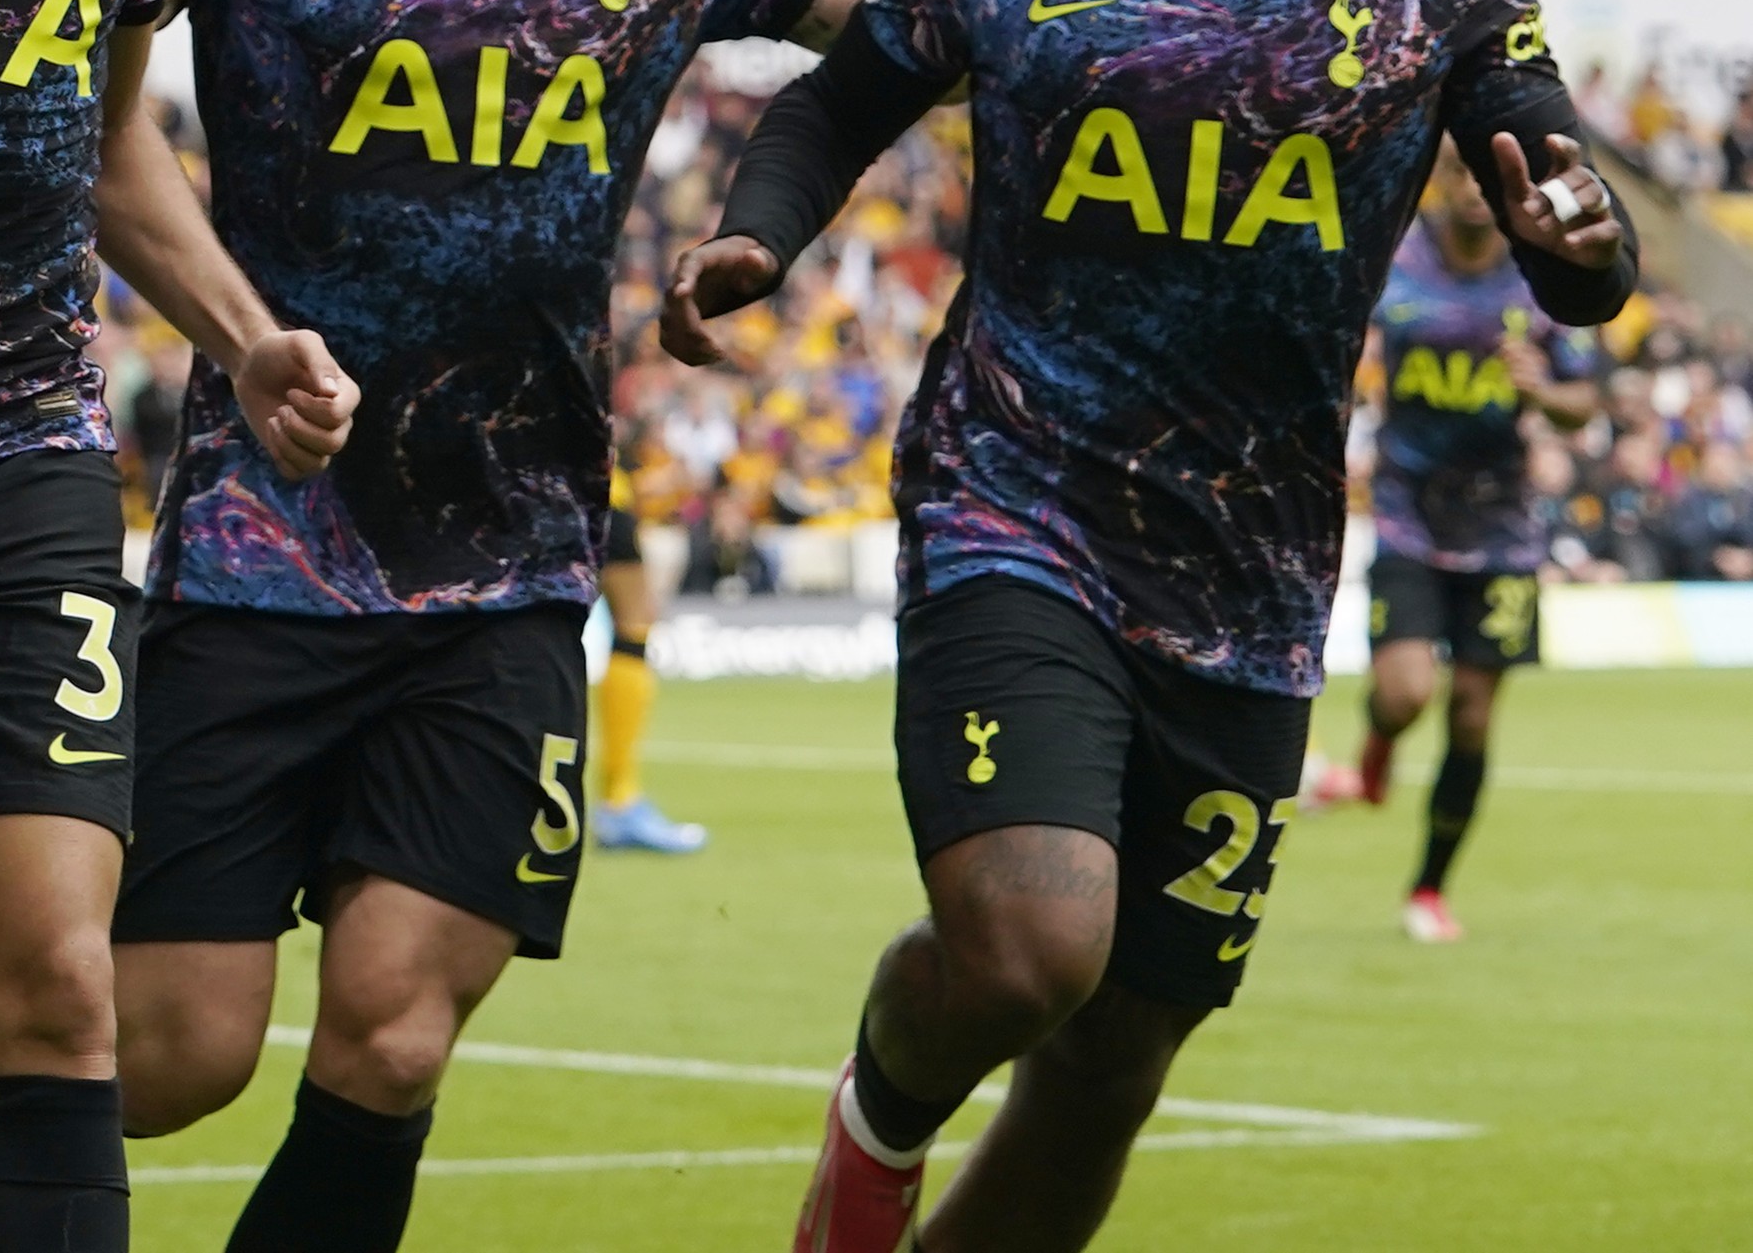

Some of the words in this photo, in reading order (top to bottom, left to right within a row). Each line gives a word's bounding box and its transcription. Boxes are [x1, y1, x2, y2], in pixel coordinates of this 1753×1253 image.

[328, 39, 611, 175] AIA
[1042, 107, 1346, 252] AIA
[1395, 346, 1517, 414] AIA
[54, 591, 123, 721] 3
[531, 733, 580, 855] 5
